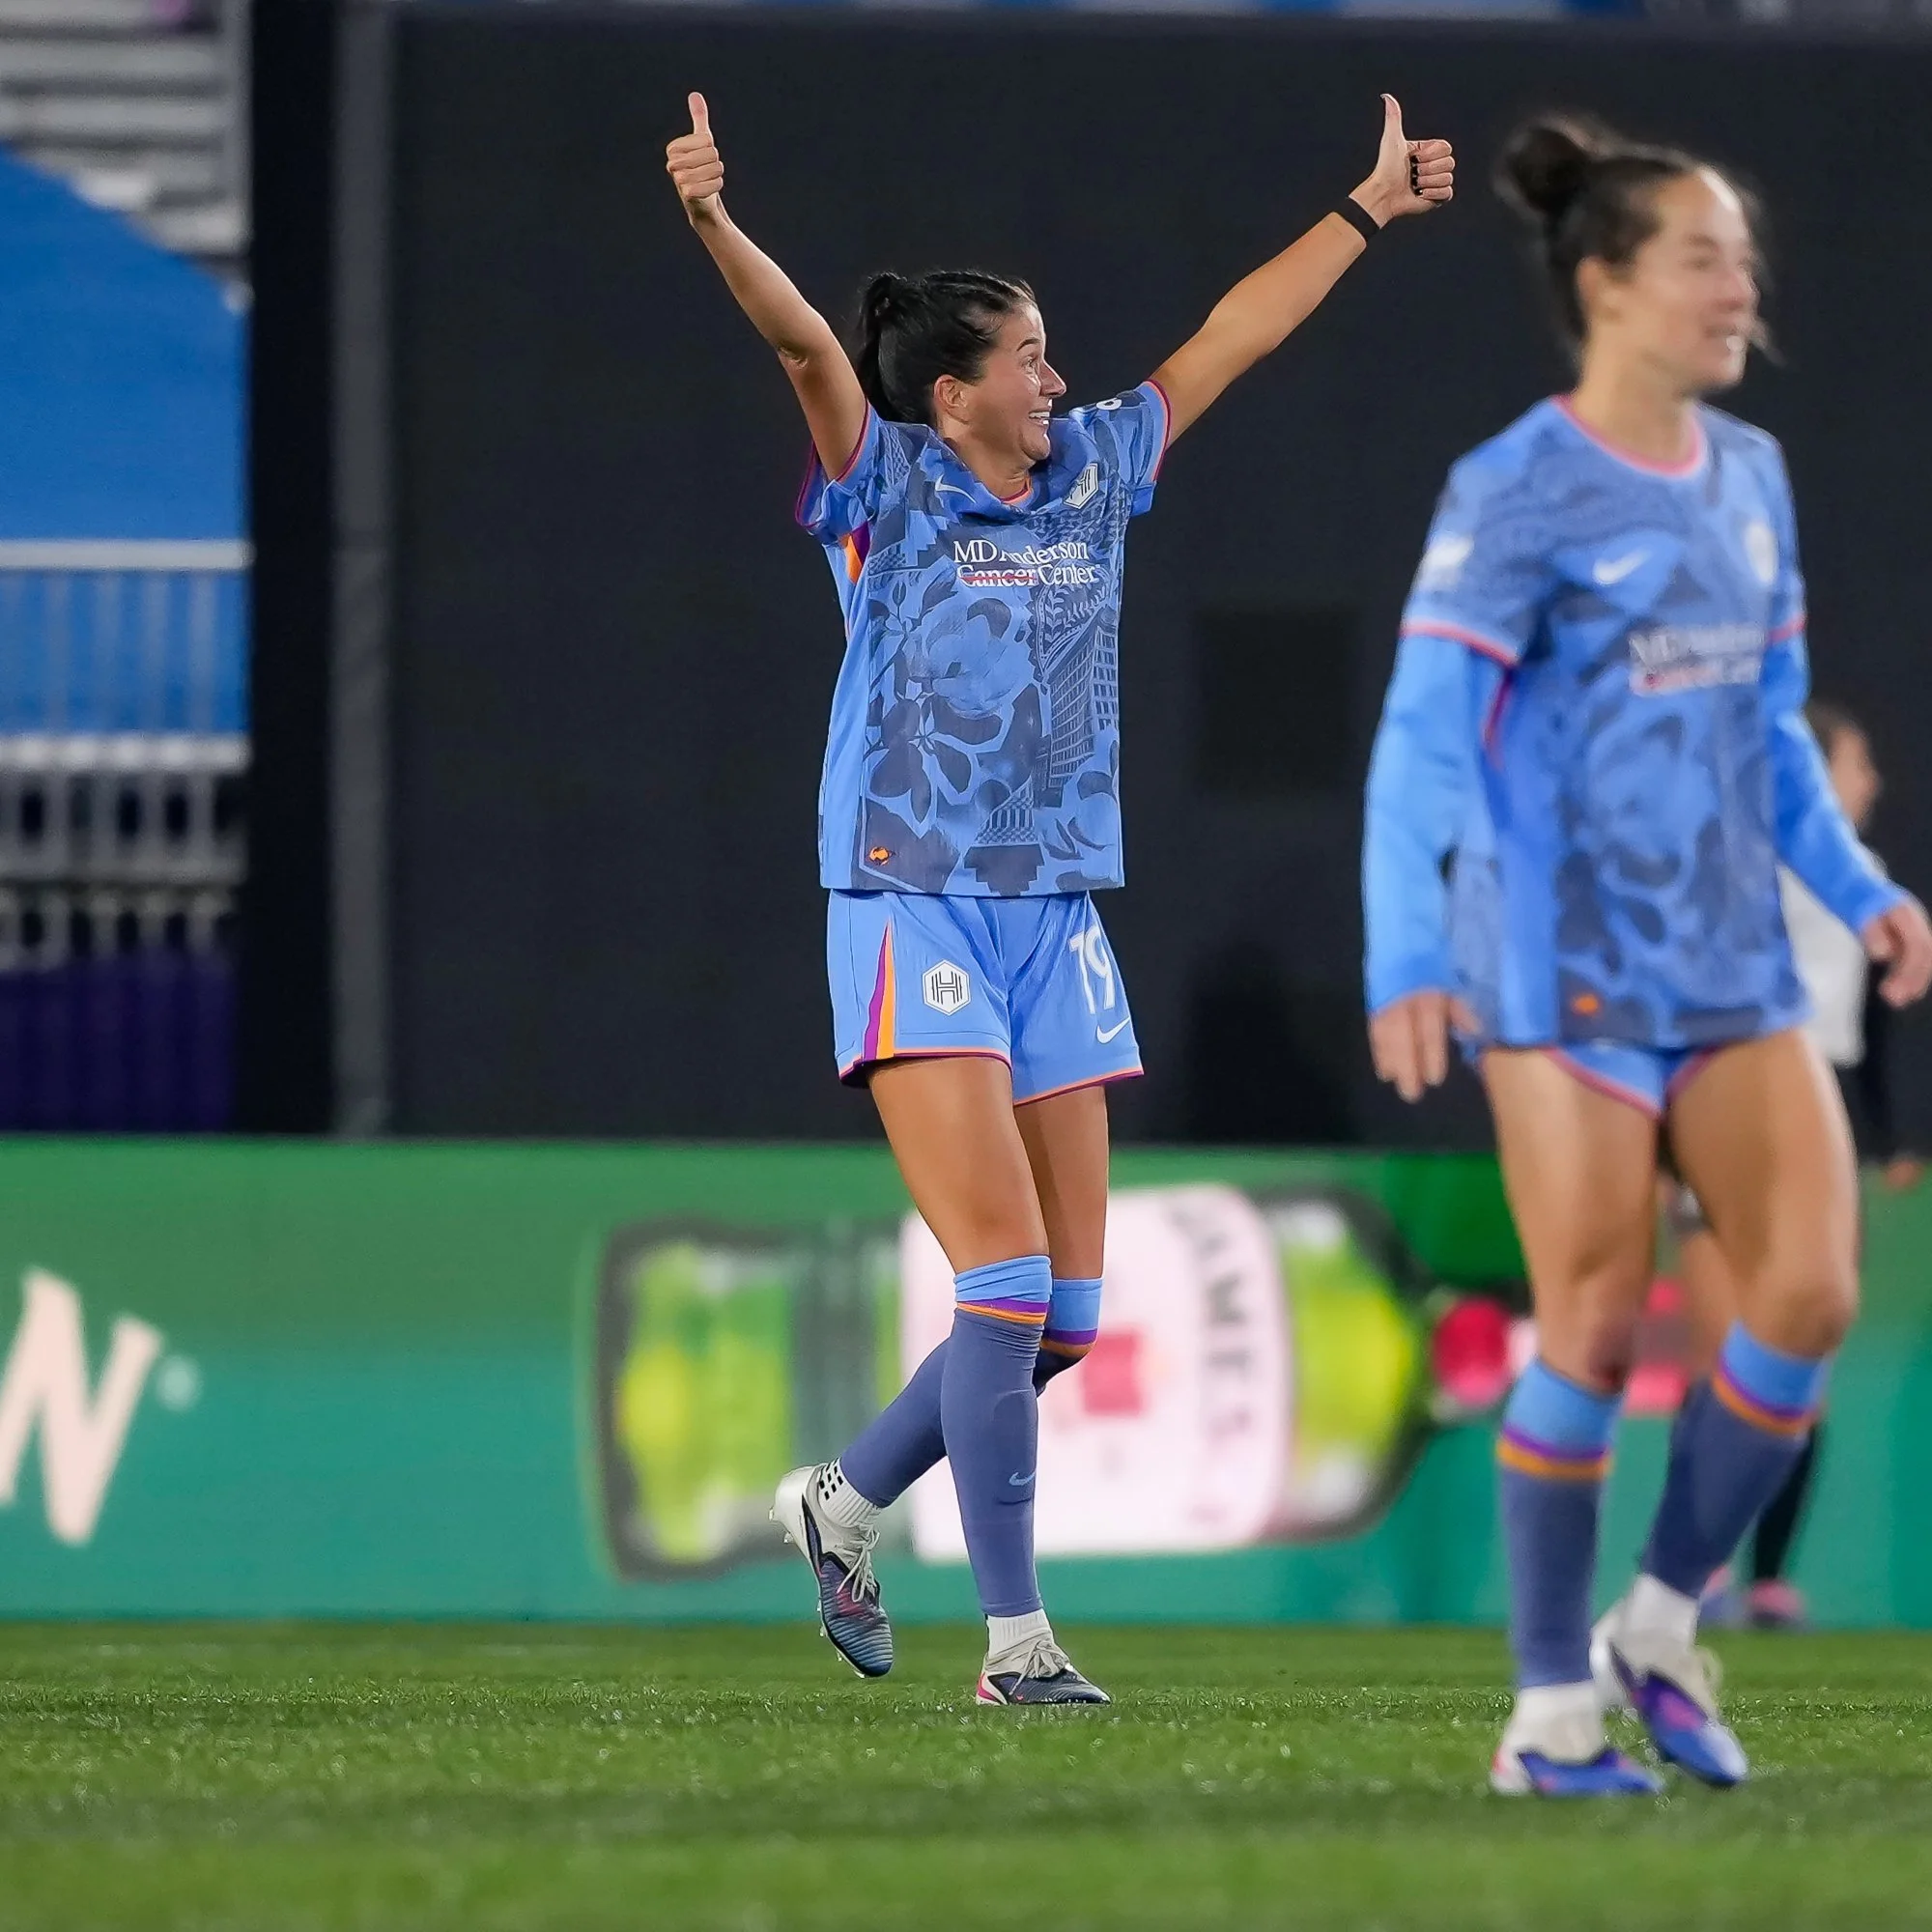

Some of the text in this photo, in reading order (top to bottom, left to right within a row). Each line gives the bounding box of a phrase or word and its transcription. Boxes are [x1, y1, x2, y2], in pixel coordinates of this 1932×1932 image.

[953, 539, 1090, 565] MD Anderson
[957, 563, 1099, 587] Cancer Center
[1069, 924, 1116, 1014] 19
